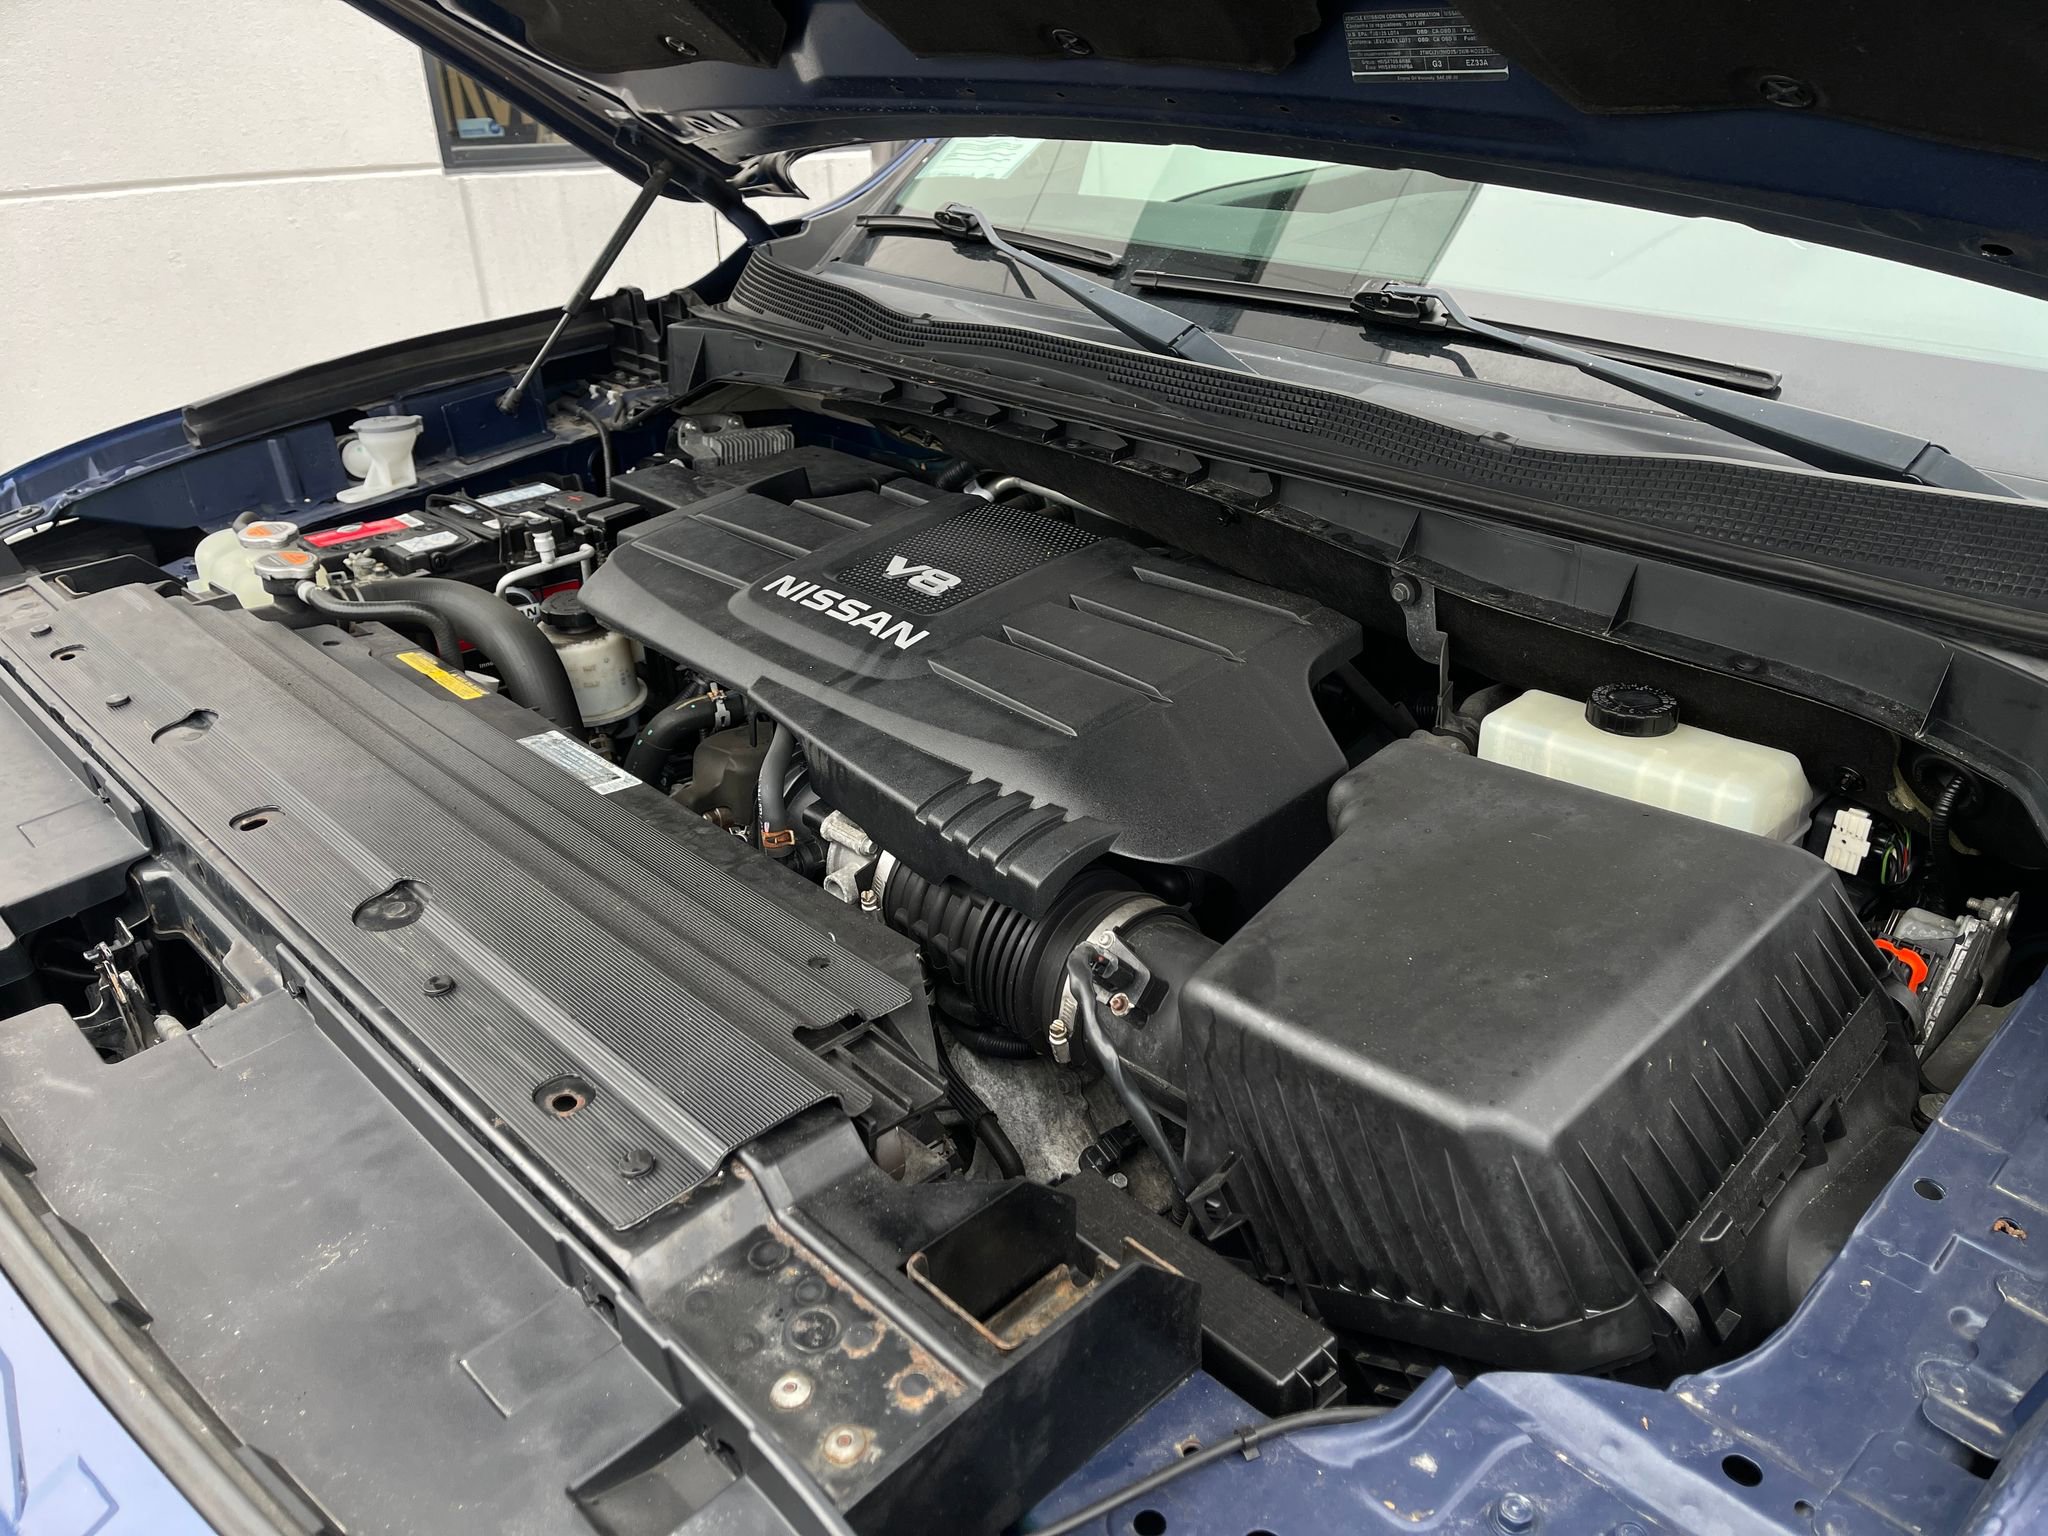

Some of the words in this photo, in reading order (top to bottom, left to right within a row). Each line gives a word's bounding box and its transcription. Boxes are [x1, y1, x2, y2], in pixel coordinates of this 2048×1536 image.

[1432, 60, 1442, 68] G3
[882, 555, 962, 597] V8
[762, 574, 930, 650] NISSAN
